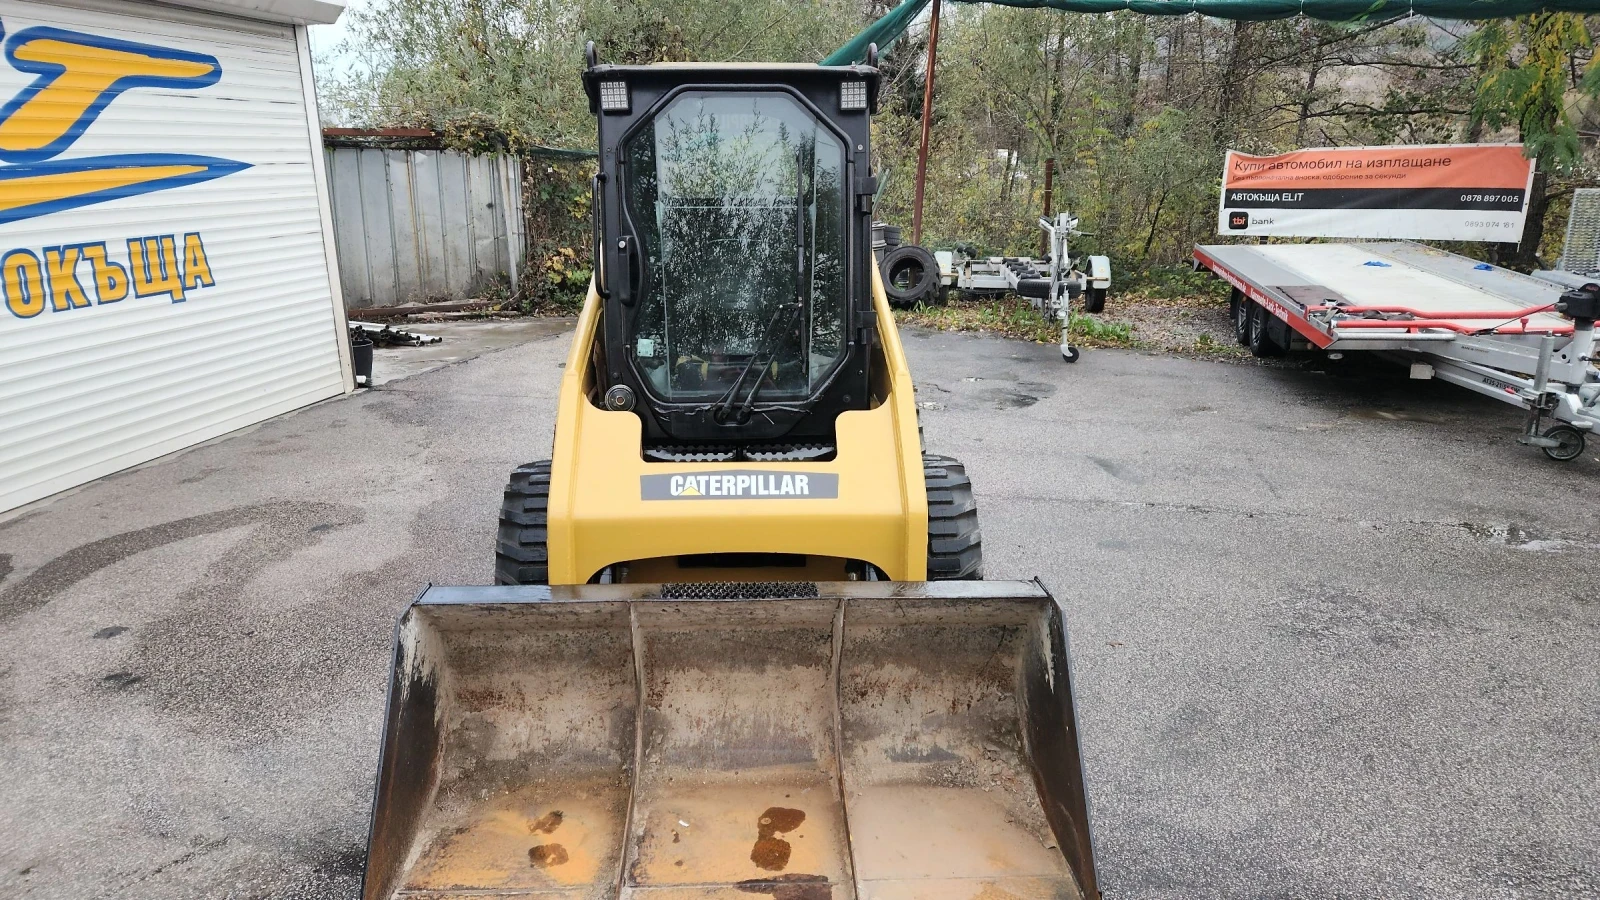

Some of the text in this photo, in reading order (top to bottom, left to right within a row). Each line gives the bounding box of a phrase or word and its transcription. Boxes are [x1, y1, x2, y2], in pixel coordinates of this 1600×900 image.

[1234, 157, 1452, 173] Купи автомобил на изплащане
[1322, 173, 1363, 181] одобрение
[1230, 192, 1305, 203] АВТОКЪЩА ELIT
[1460, 194, 1520, 203] 0878 897 005
[1232, 216, 1275, 225] tbi bank
[0, 231, 215, 319] ОКЪЩА
[670, 474, 810, 496] CATERPILLAR
